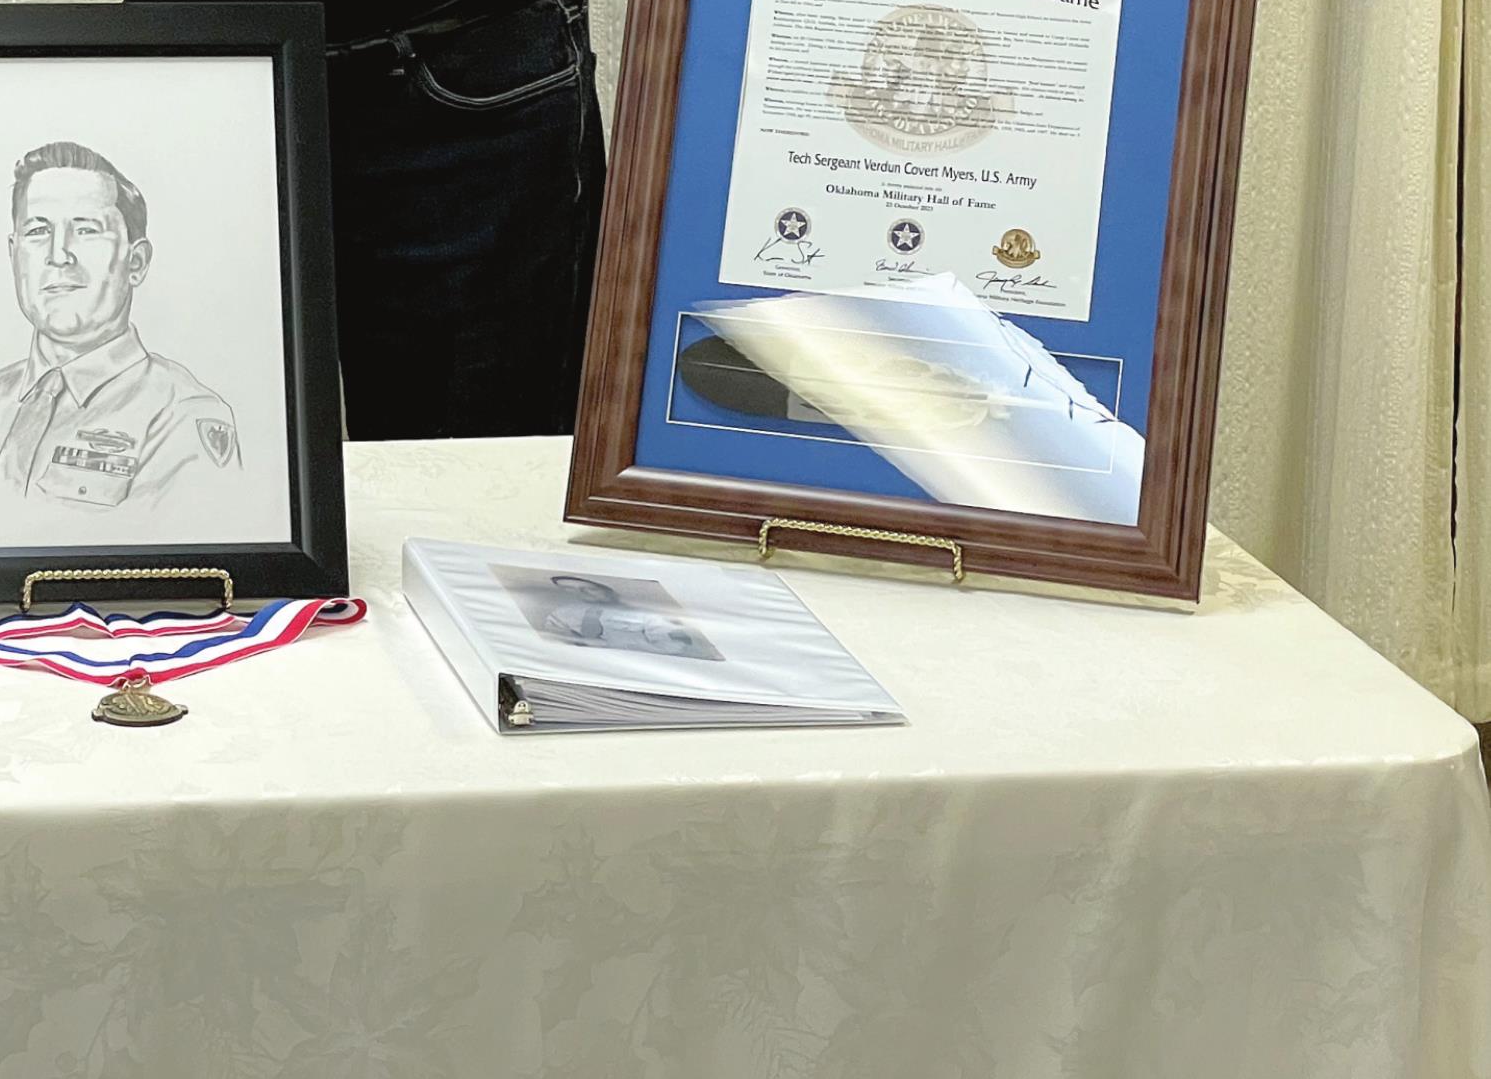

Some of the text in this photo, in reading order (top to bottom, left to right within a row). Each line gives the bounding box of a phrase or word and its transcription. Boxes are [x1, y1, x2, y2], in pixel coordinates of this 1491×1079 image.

[788, 151, 1037, 190] Tech Sergeant Verdun Covert Myers, U.S. Army
[825, 184, 880, 199] Oklahoma
[882, 189, 925, 205] Military
[927, 194, 950, 206] Hall
[952, 197, 964, 207] of
[967, 198, 997, 210] Fame
